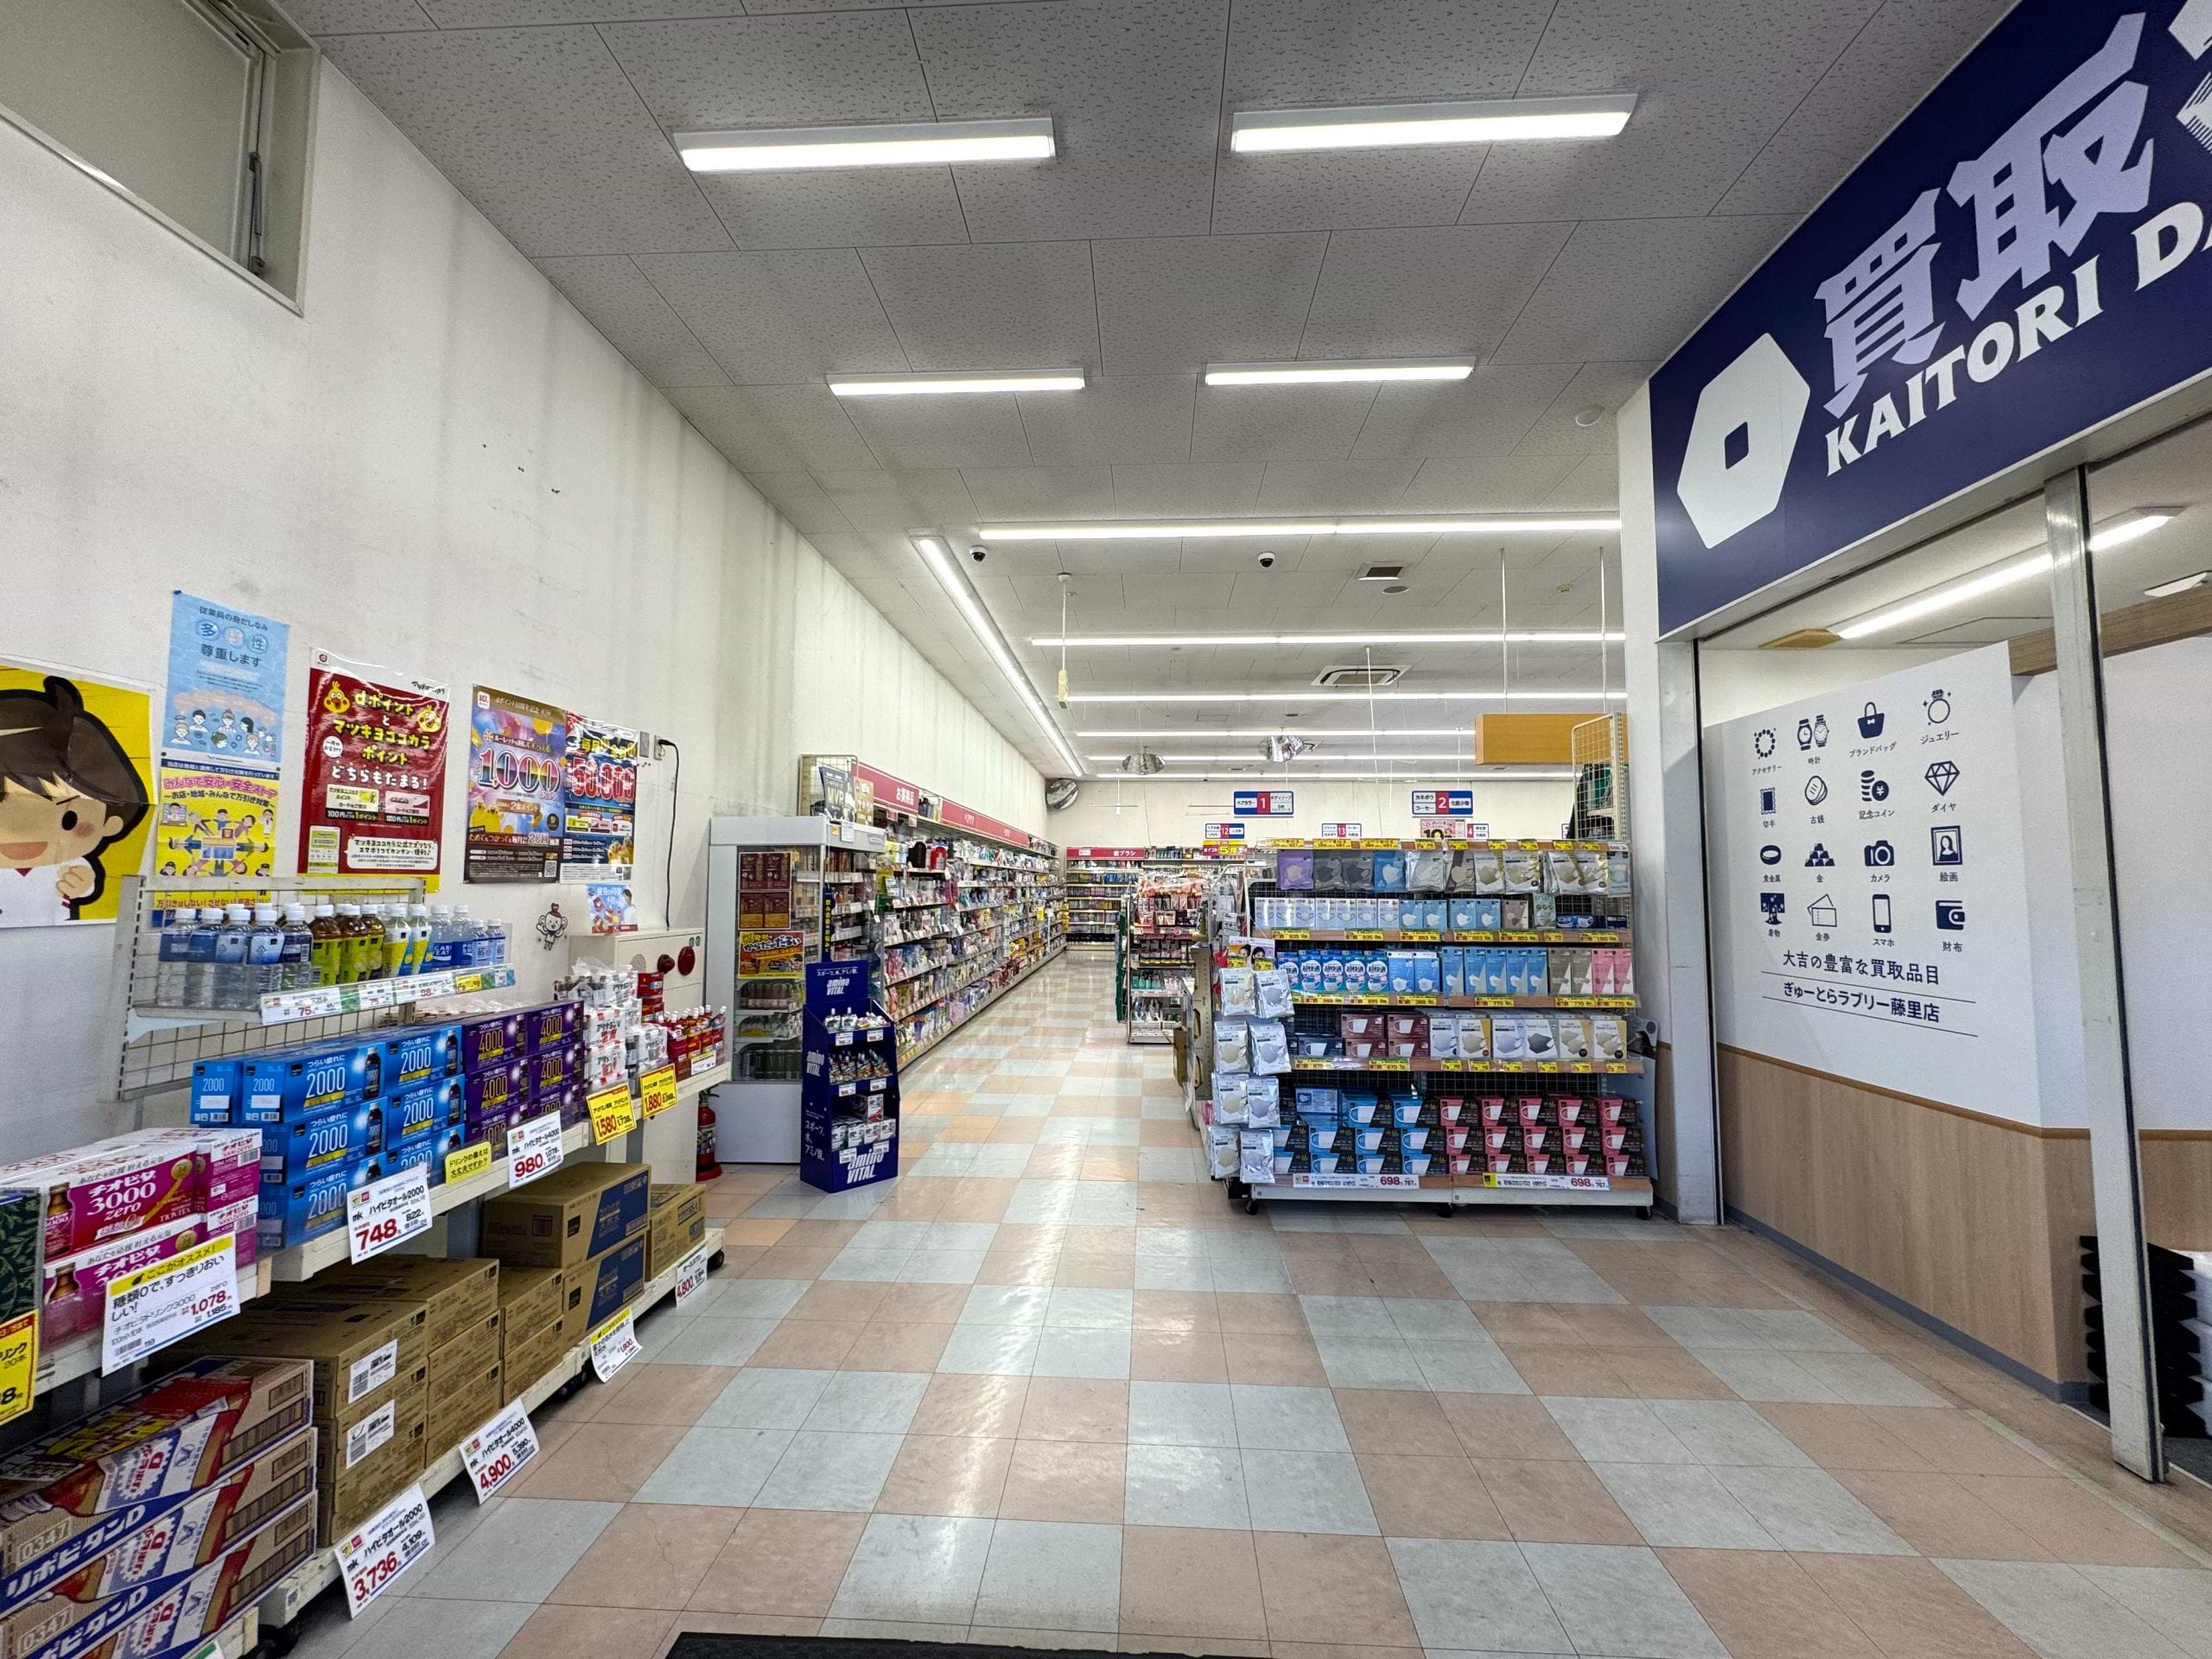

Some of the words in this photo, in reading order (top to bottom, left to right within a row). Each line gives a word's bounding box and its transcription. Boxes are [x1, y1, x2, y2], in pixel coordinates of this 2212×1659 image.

[1815, 11, 2212, 419] 買取
[1826, 255, 2104, 478] KAITORI
[2132, 201, 2212, 292] D
[200, 643, 262, 668] 尊重します
[354, 690, 415, 715] dポイント
[382, 715, 390, 726] と
[333, 719, 431, 750] マツキヨココカラ
[1920, 730, 1960, 746] ジュエリー
[363, 744, 408, 766] ポイント
[1849, 741, 1897, 758] ブランドバッグ
[1751, 765, 1783, 775] アクセサリー
[1808, 756, 1821, 766] 時計
[164, 775, 278, 798] みんなで安心・安全ストア
[1260, 797, 1266, 809] 1
[1438, 797, 1447, 809] 2
[1931, 802, 1956, 813] ダイヤ
[1810, 814, 1825, 824] 古銭
[1859, 809, 1895, 820] 記念コイン
[1221, 827, 1229, 836] 12
[1338, 827, 1345, 836] 13
[1816, 874, 1824, 883] 金
[1871, 874, 1891, 883] カメラ
[1939, 871, 1959, 883] 絵画
[1815, 931, 1830, 942] 金券
[1872, 938, 1895, 948] スマホ
[1942, 942, 1962, 953] 財布
[1783, 949, 1940, 985] 大吉の豊富な買取品目
[827, 976, 849, 988] amino
[827, 986, 845, 995] VITAL
[1783, 981, 1940, 1023] ぎゅーとらラブリー藤里店
[540, 1016, 563, 1037] 4000
[402, 1036, 431, 1047] つらい疲れに
[479, 1029, 504, 1052] 4000
[307, 1054, 346, 1068] つらい疲れに
[401, 1046, 431, 1075] 2000
[540, 1059, 563, 1080] 4000
[202, 1077, 225, 1092] 2000
[253, 1077, 275, 1092] 2000
[306, 1066, 346, 1098] 2000
[483, 1075, 508, 1100] 4000
[404, 1087, 434, 1099] つらい疲れに
[310, 1112, 348, 1128] つらい疲れに
[404, 1097, 434, 1128] 2000
[262, 1139, 278, 1153] 000
[308, 1124, 348, 1158] 2000
[847, 1148, 885, 1170] amino
[89, 1169, 157, 1198] チオビタ
[309, 1170, 347, 1188] つらい疲れに
[847, 1164, 877, 1185] VITAL
[87, 1182, 156, 1216] 3000
[308, 1182, 346, 1220] 2000
[352, 1211, 364, 1223] mk
[369, 1185, 424, 1215] ハイビタオール2000
[105, 1201, 142, 1222] zero
[93, 1244, 162, 1277] チオビタ
[147, 1244, 216, 1280] ここがオススメ！
[112, 1255, 225, 1309] 糖類0で、すっきりおい
[210, 1281, 227, 1293] zero
[364, 1503, 423, 1557] ハイビタオール2000
[7, 1504, 146, 1599] リポビタンD
